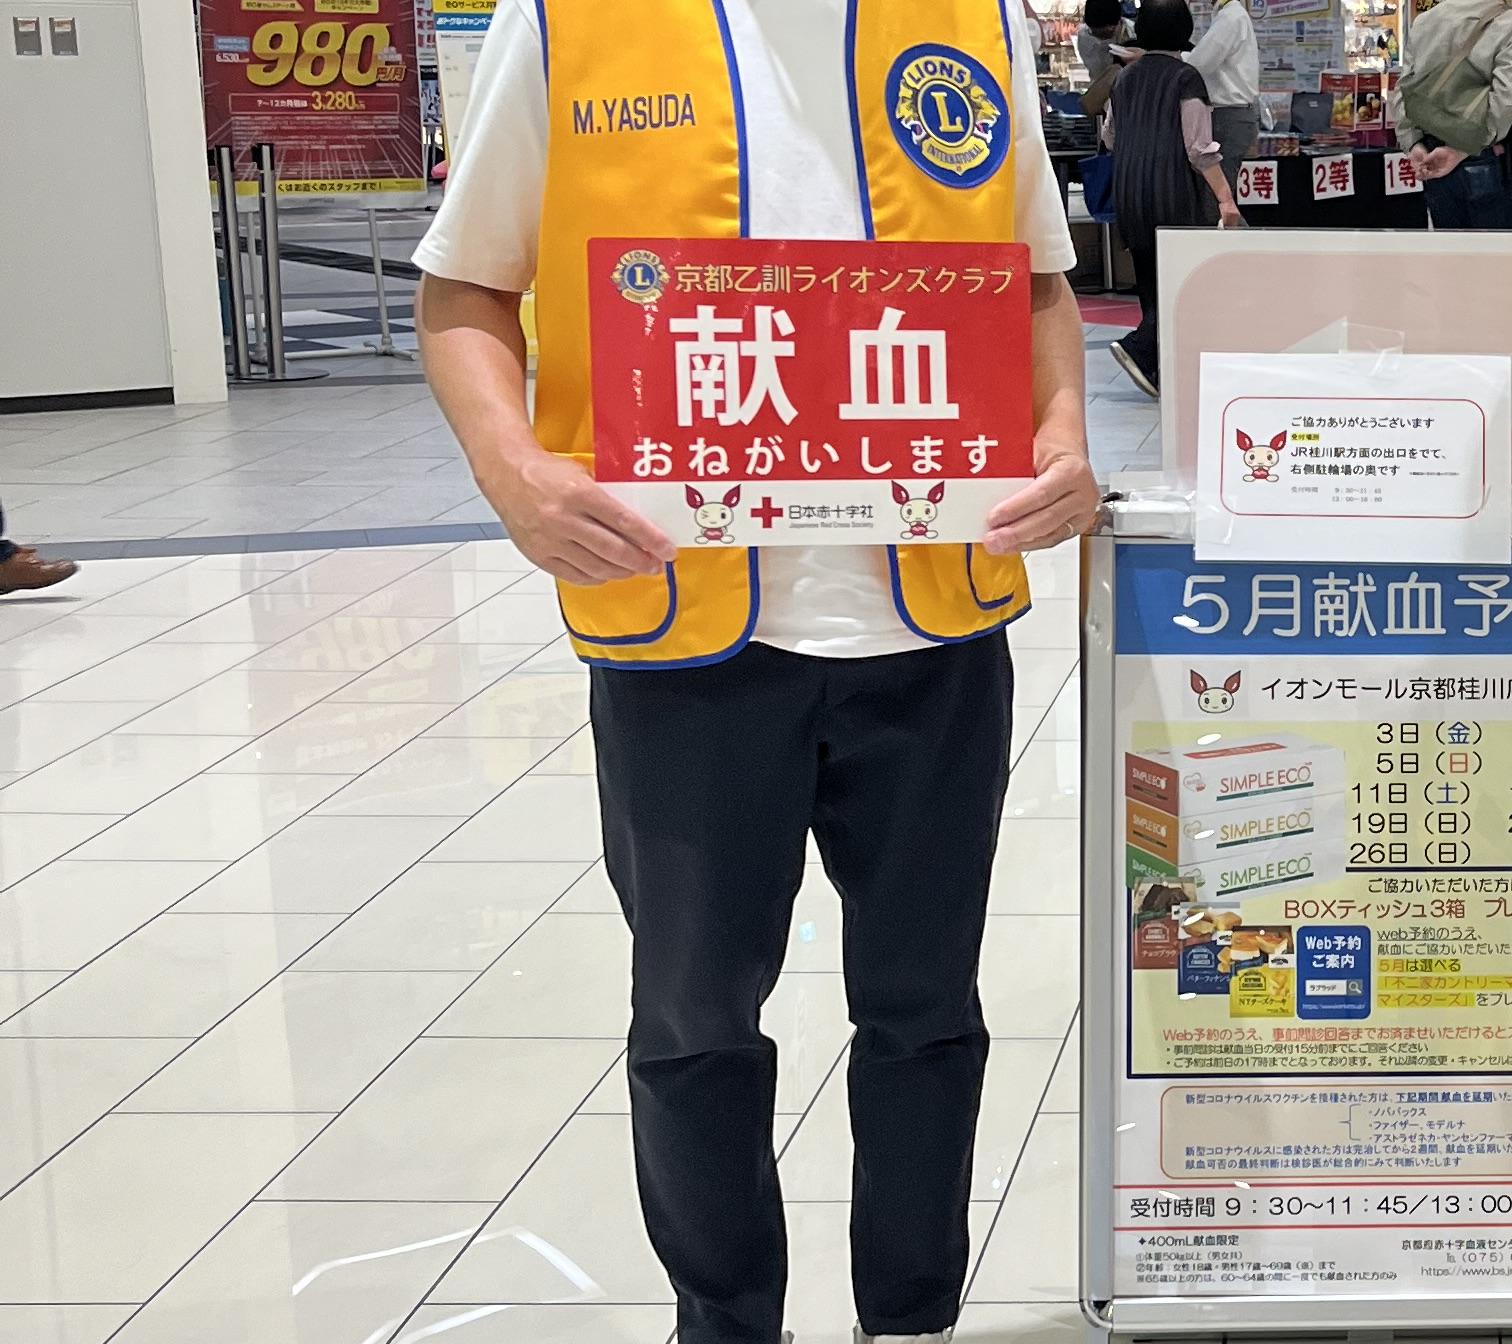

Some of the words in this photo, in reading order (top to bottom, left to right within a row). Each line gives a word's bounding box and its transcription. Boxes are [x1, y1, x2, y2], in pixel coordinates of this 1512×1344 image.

[436, 17, 493, 25] おトクなキャンペー
[246, 21, 391, 86] 980
[907, 60, 967, 84] LIONS
[572, 93, 697, 135] M.YASUDA
[930, 92, 964, 132] L
[927, 144, 984, 165] INTERNATIONAL
[1239, 166, 1274, 199] 3等
[1315, 159, 1350, 193] 2等
[1387, 158, 1417, 189] 1等
[675, 263, 1014, 295] 京都乙訓ライオンズクラブ
[668, 304, 960, 428] 献血
[1291, 416, 1435, 430] ご協力ありがとうございます
[632, 434, 1000, 478] おねがいします
[788, 504, 874, 519] 日本赤十字社
[1219, 770, 1275, 794] SIMPLE
[1277, 764, 1311, 786] ECO
[1219, 818, 1275, 841] SIMPLE
[1277, 811, 1311, 833] ECO
[1219, 865, 1275, 888] SIMPLE
[1277, 856, 1311, 879] ECO
[1284, 899, 1465, 919] BOXティッシュ3箱
[1305, 934, 1361, 951] Web予約
[1312, 954, 1355, 969] ご案内
[1378, 959, 1461, 973] 5月は選べる
[1130, 1197, 1215, 1218] 受付時間
